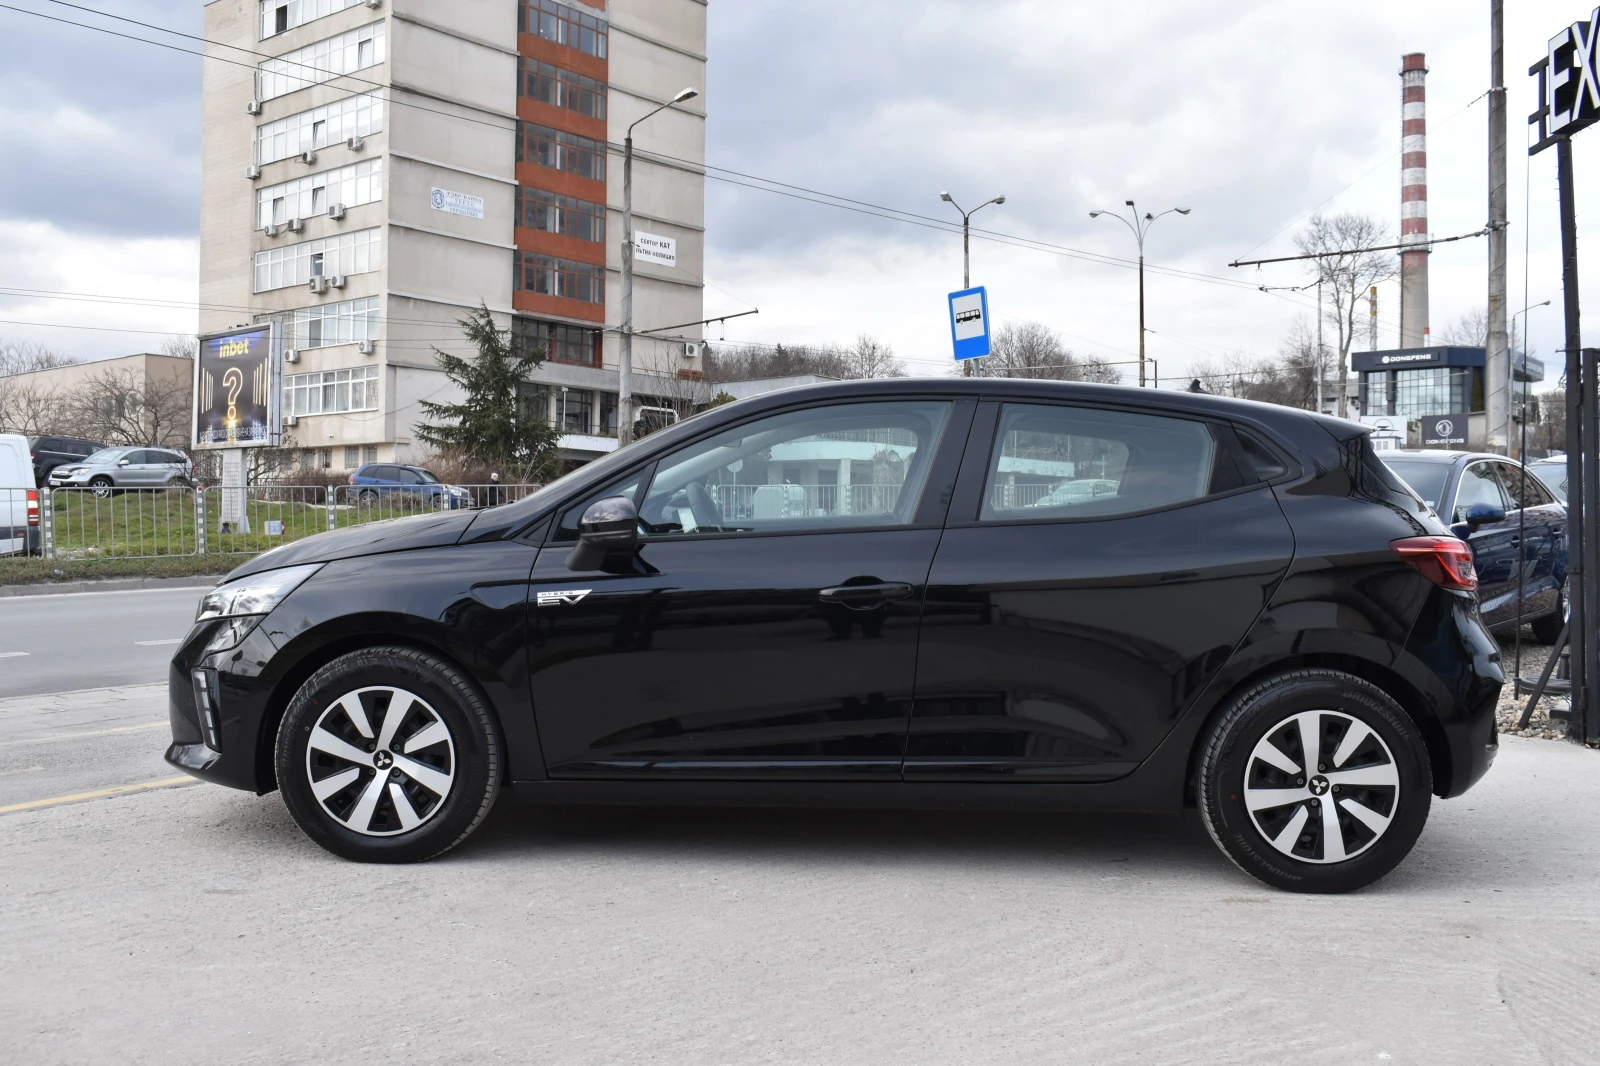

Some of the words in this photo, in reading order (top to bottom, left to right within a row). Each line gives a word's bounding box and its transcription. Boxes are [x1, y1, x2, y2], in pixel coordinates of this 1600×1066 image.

[1548, 6, 1600, 134] EX
[640, 238, 659, 246] СЕКТОР
[659, 241, 671, 249] КАТ
[635, 247, 651, 256] ПЪТНА
[219, 338, 249, 358] inbet
[1390, 353, 1432, 362] DONGFENG
[537, 594, 589, 606] EV
[1341, 687, 1411, 741] BRIDGESTONE
